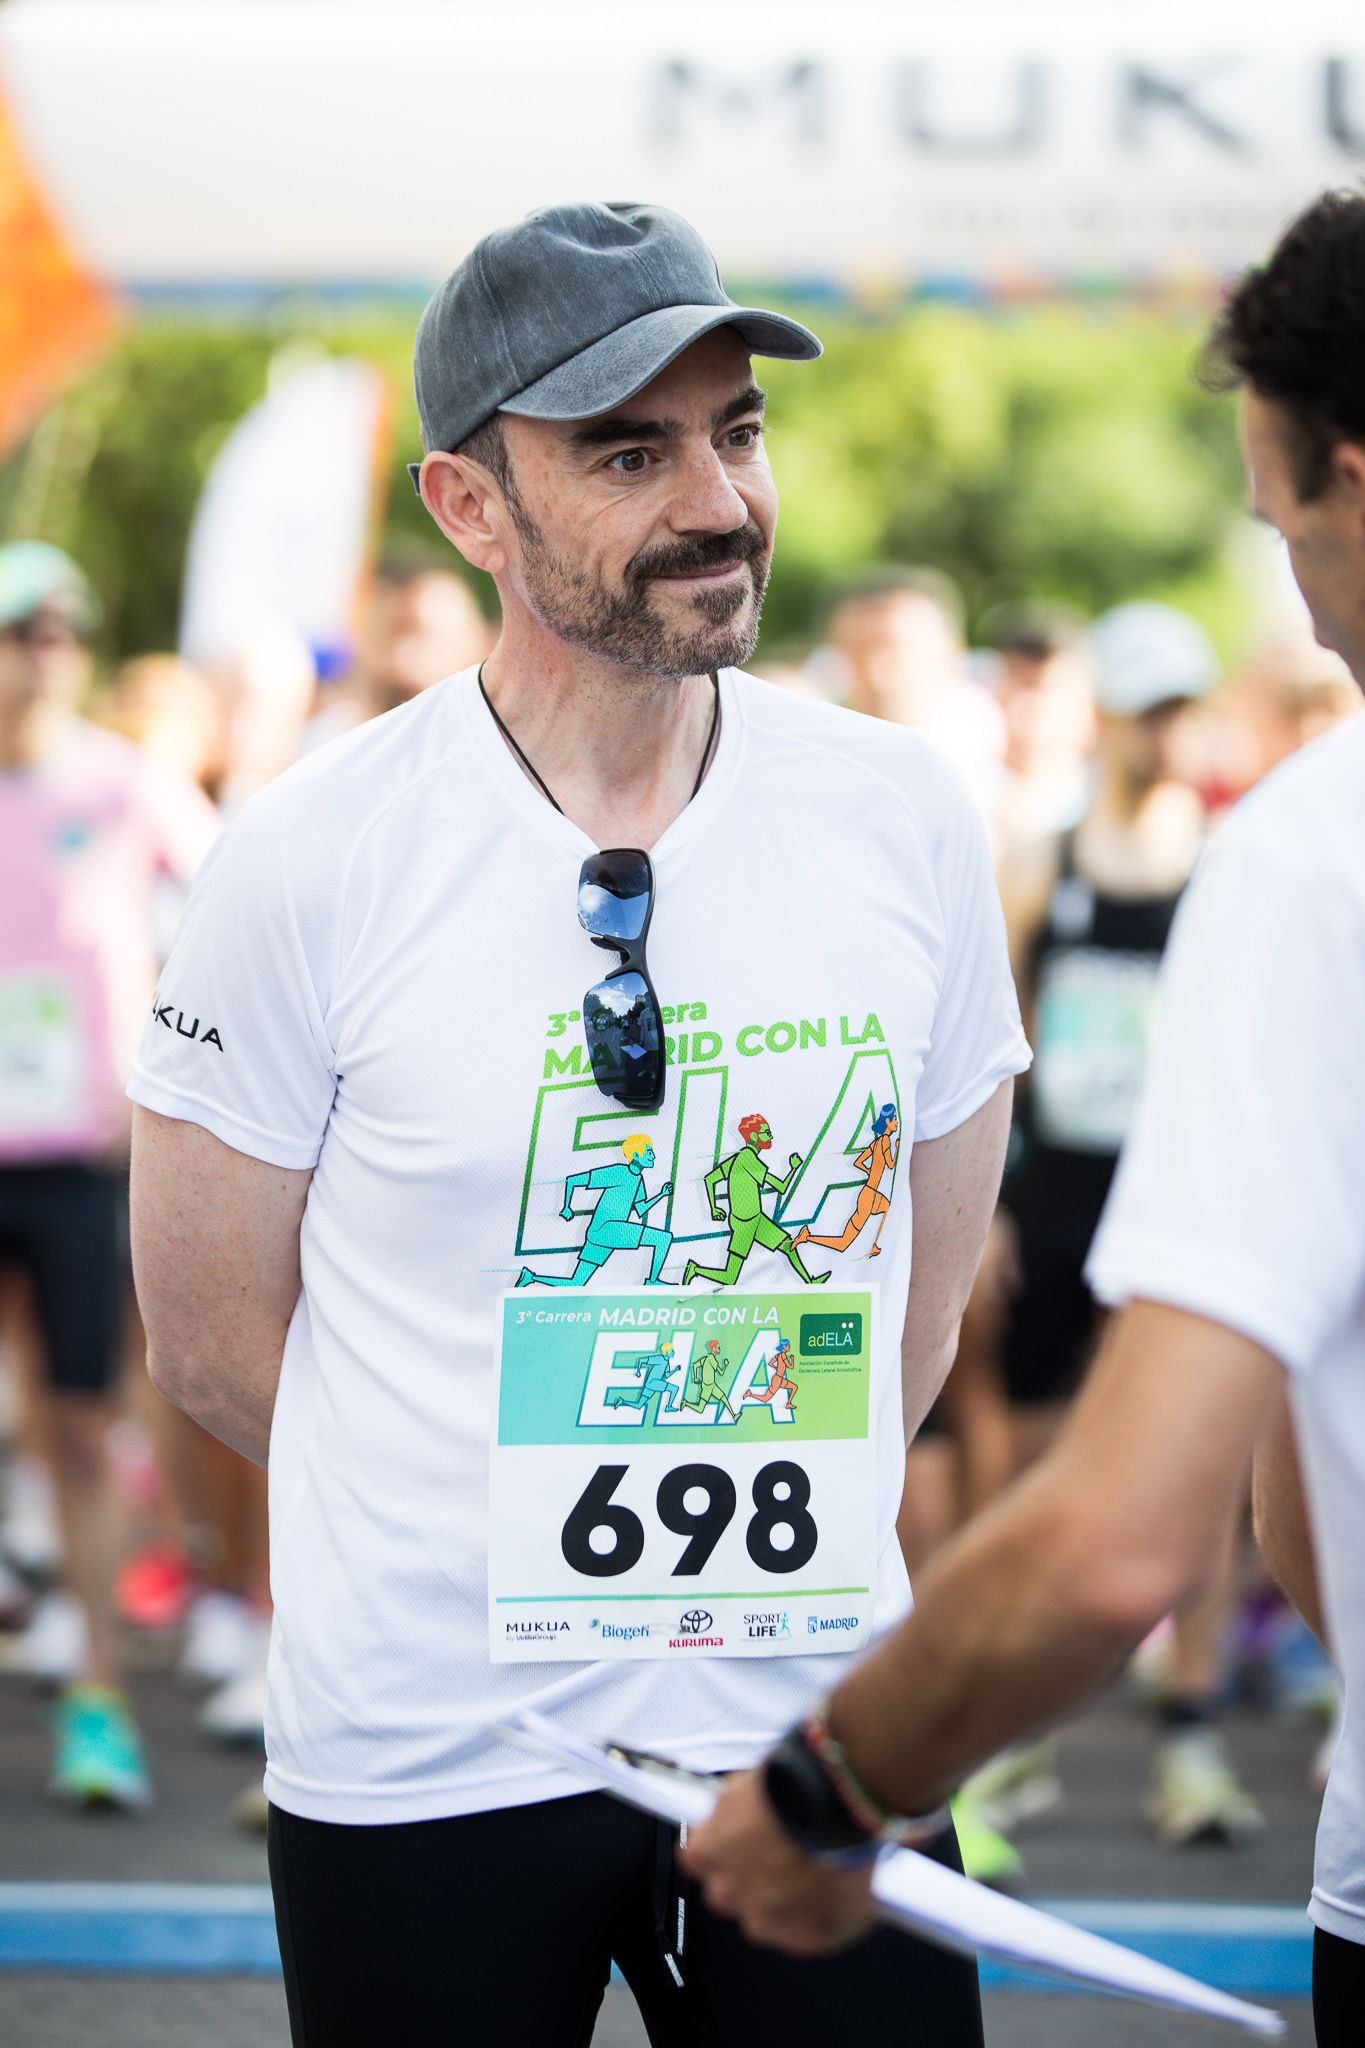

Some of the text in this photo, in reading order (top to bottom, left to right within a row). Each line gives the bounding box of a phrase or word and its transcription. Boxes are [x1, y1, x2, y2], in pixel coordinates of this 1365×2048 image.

[645, 54, 1365, 162] MUK
[152, 998, 225, 1053] KUA
[735, 1025, 827, 1059] CON
[840, 1013, 886, 1046] LA
[514, 1048, 901, 1257] ELA
[535, 1310, 592, 1324] Carrera
[598, 1307, 697, 1327] MADRID
[702, 1306, 748, 1326] CON
[751, 1306, 779, 1325] LA
[807, 1331, 853, 1347] adELA
[575, 1328, 796, 1428] ELA
[561, 1460, 818, 1577] 698
[506, 1621, 571, 1633] MUKUA
[743, 1613, 781, 1625] SPORT
[819, 1616, 859, 1631] MADRID
[602, 1624, 650, 1640] Biogen
[748, 1625, 777, 1637] LIFE
